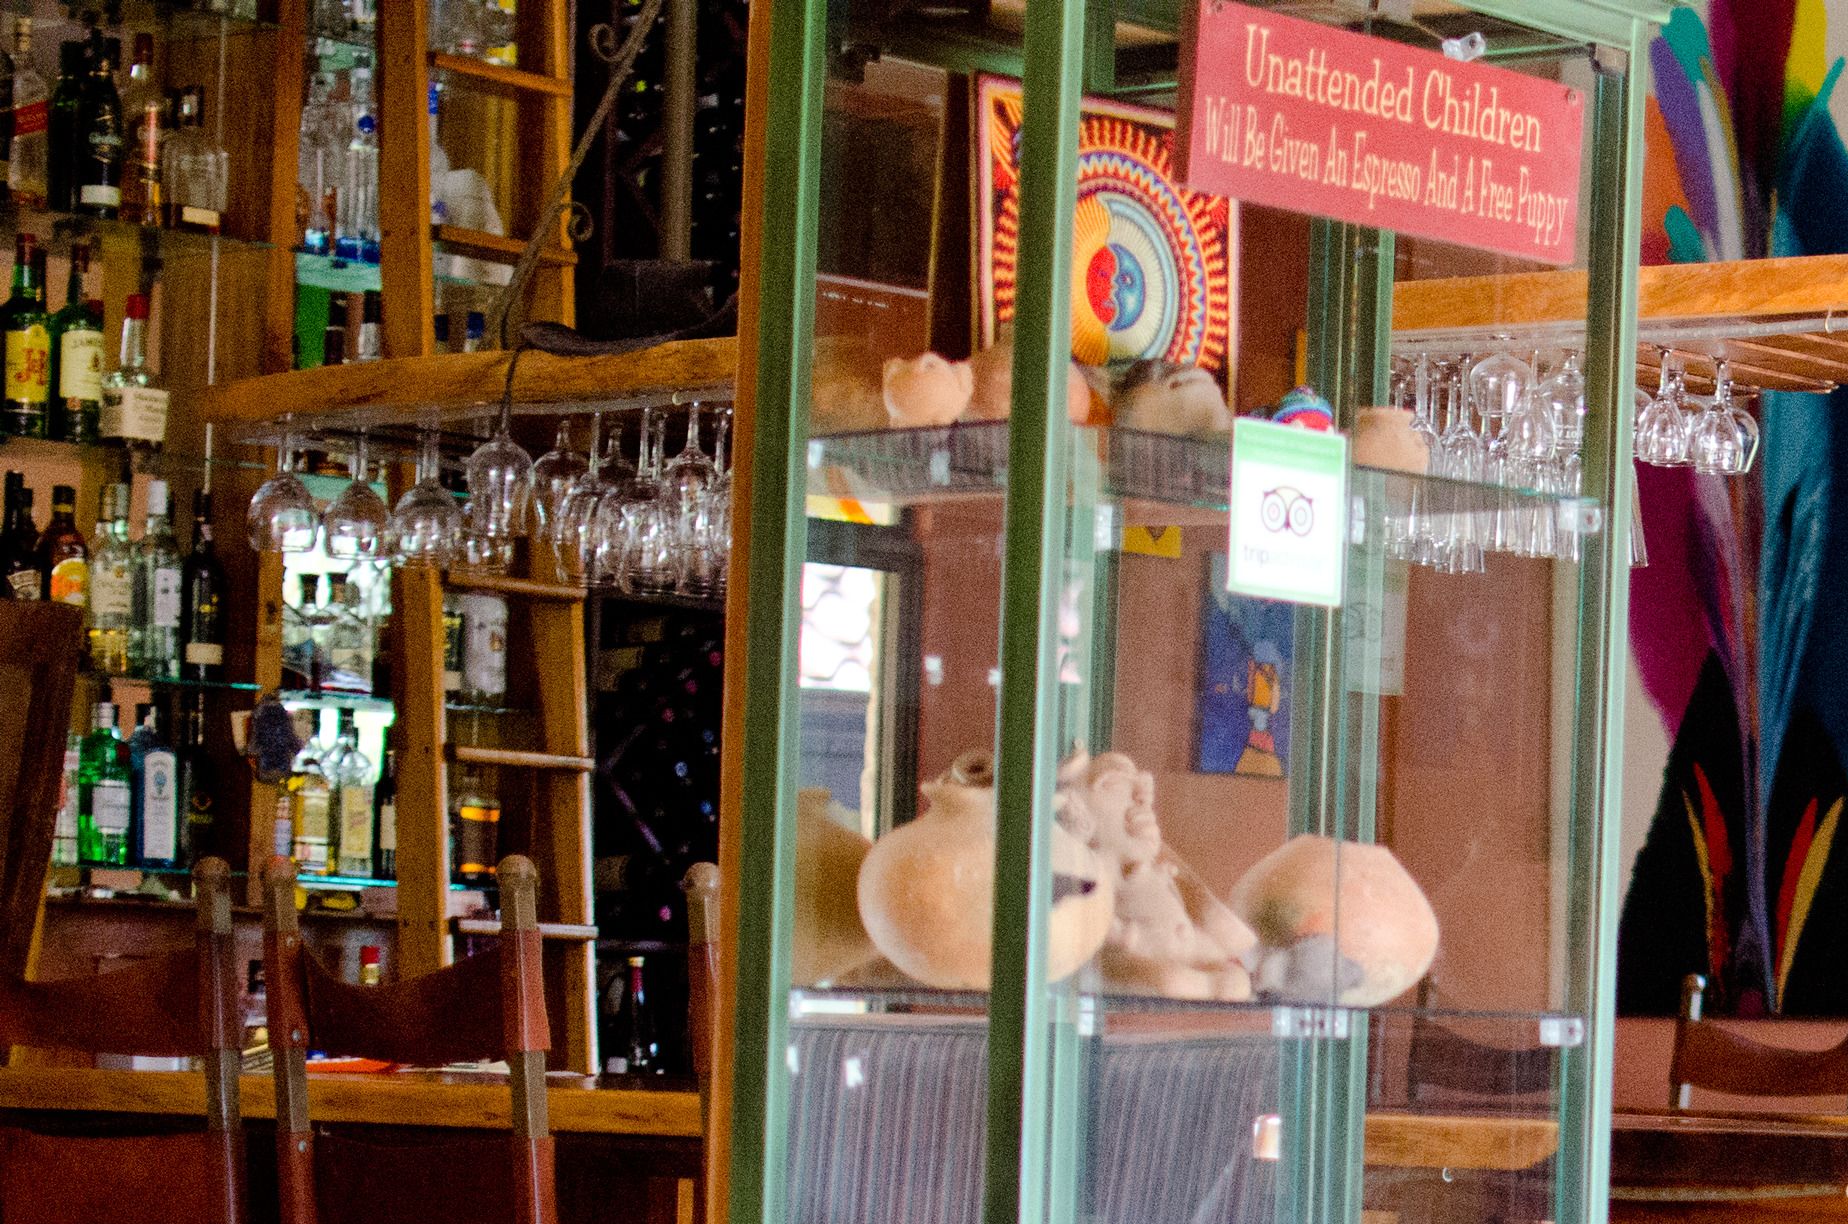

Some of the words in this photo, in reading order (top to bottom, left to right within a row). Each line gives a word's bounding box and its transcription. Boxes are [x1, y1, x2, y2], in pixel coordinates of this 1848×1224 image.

[1246, 24, 1413, 124] Unattended
[1423, 69, 1541, 152] Children
[1205, 97, 1240, 163] Will
[1243, 104, 1265, 169] Be
[1270, 112, 1319, 180] Given
[1323, 125, 1347, 187] An
[1351, 130, 1420, 210] Espresso
[1424, 148, 1459, 210] And
[1461, 156, 1474, 214] A
[1477, 159, 1513, 222] Free
[1516, 166, 1569, 246] Puppy
